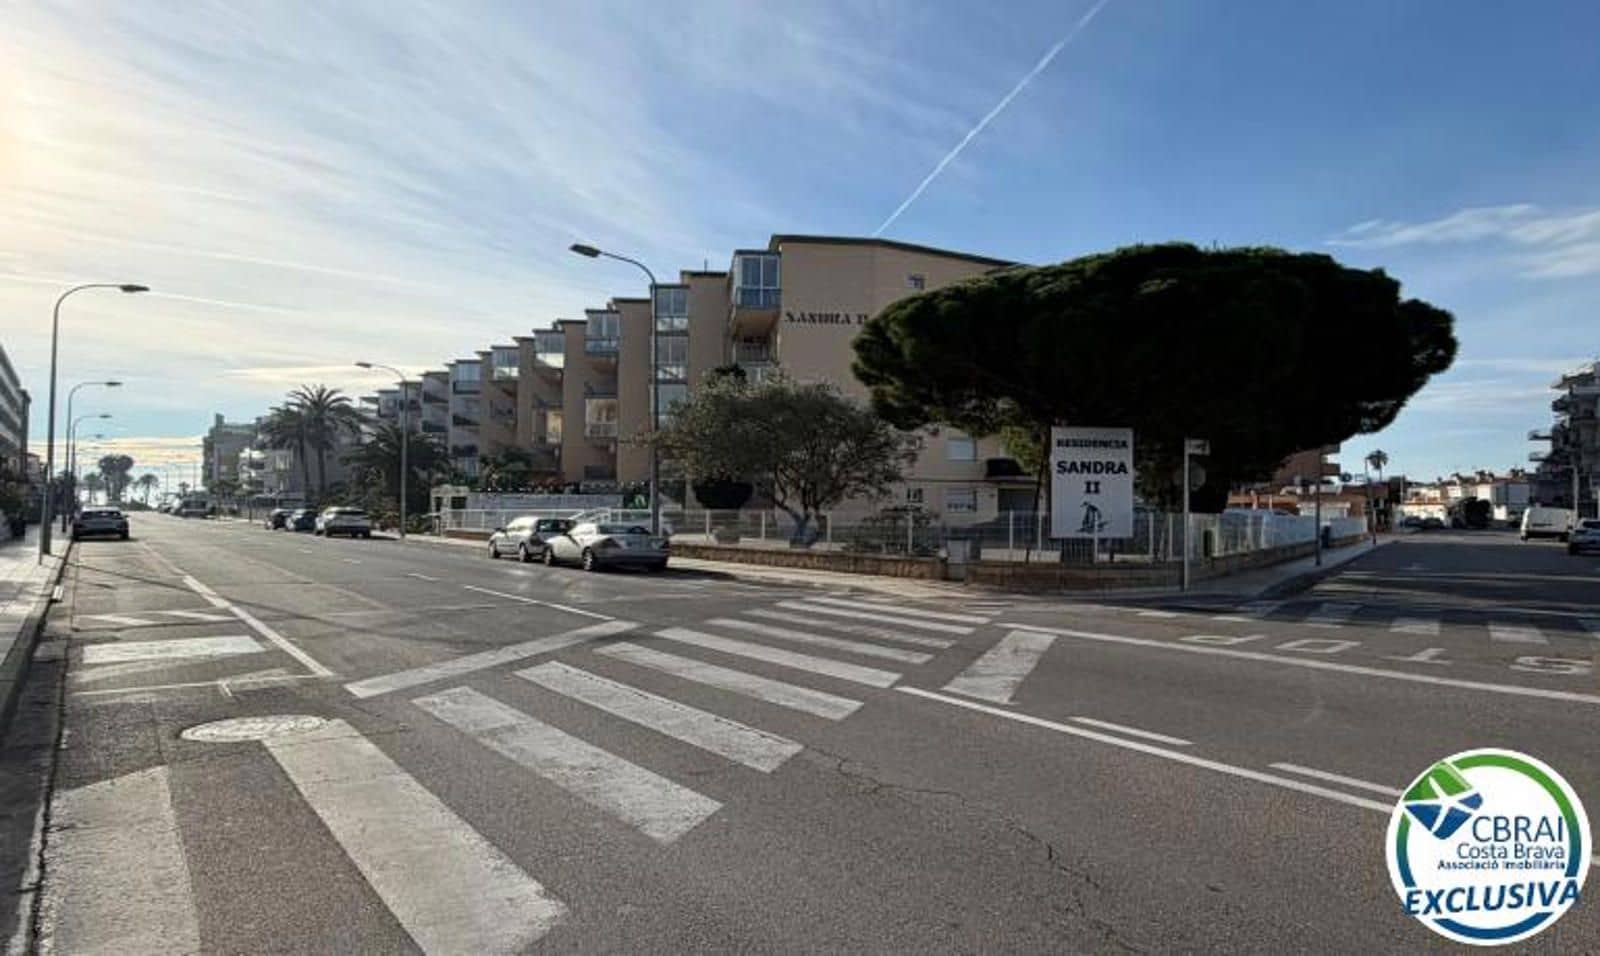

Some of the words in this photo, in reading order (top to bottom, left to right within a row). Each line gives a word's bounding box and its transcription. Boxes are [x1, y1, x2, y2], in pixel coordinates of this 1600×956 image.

[1056, 438, 1129, 450] RESIDENCIA
[1056, 460, 1130, 475] SANDRA
[1085, 481, 1101, 495] II
